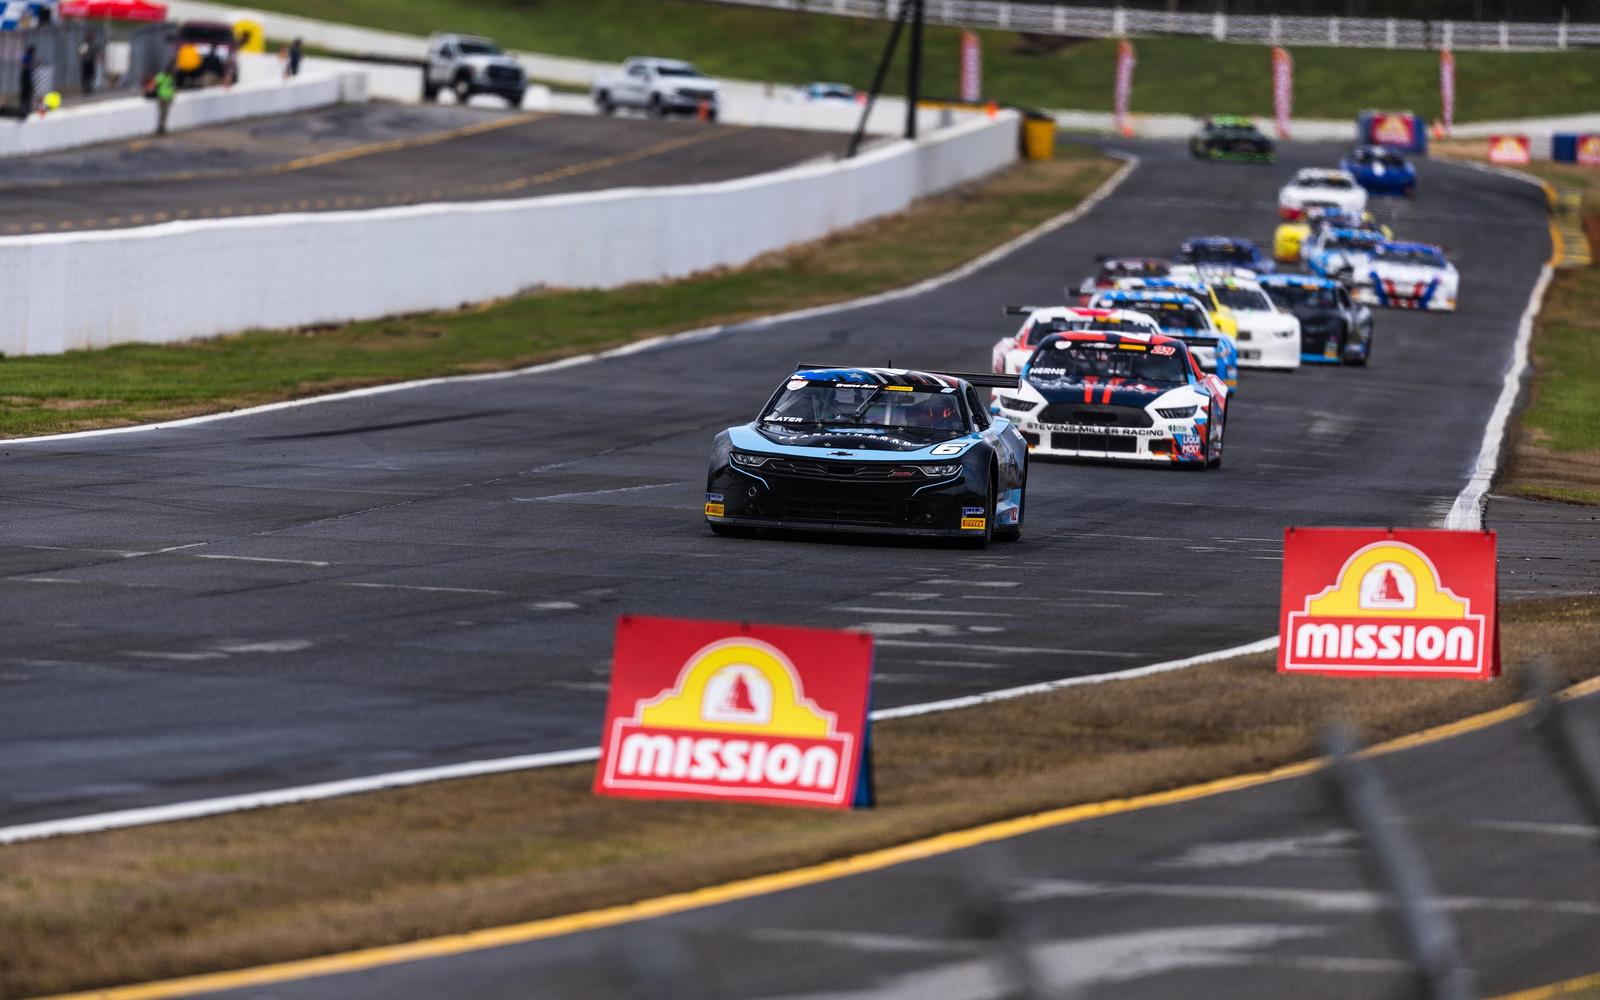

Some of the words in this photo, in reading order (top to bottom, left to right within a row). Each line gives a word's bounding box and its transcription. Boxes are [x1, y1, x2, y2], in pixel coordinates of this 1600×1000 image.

[1027, 422, 1118, 435] STEVENS-MILLER
[1182, 434, 1200, 444] LIQUI
[929, 442, 969, 456] 6
[1182, 444, 1201, 453] MOLY
[1295, 622, 1475, 661] MISSION
[618, 731, 839, 790] MISSION
